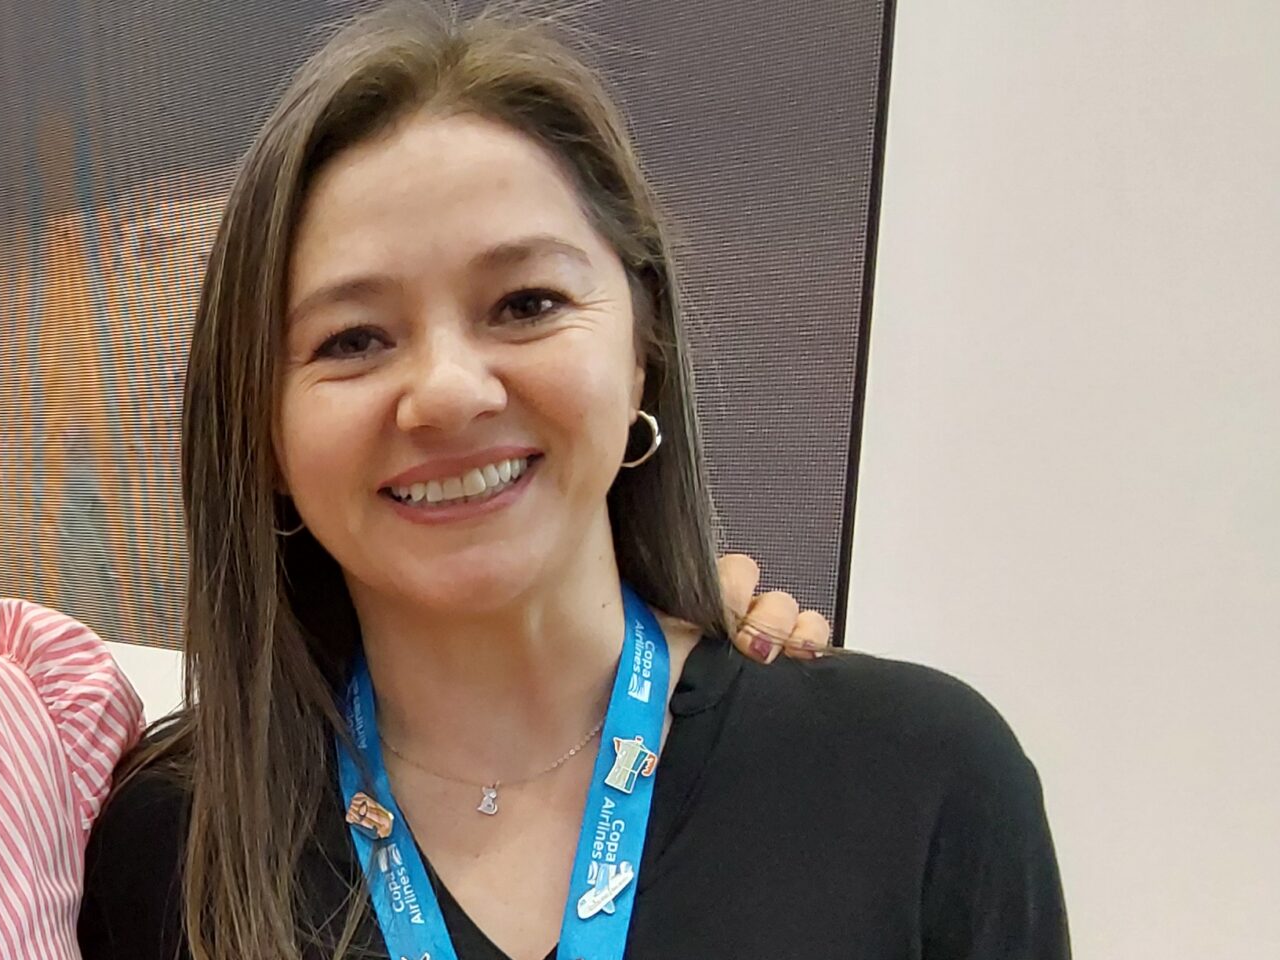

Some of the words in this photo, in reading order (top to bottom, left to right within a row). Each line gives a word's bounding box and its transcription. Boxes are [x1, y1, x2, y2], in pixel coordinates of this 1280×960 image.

[632, 619, 645, 673] Airlines
[642, 640, 655, 679] Copa
[591, 796, 615, 860] Airlines
[604, 819, 625, 863] Copa
[396, 867, 425, 925] Airlines
